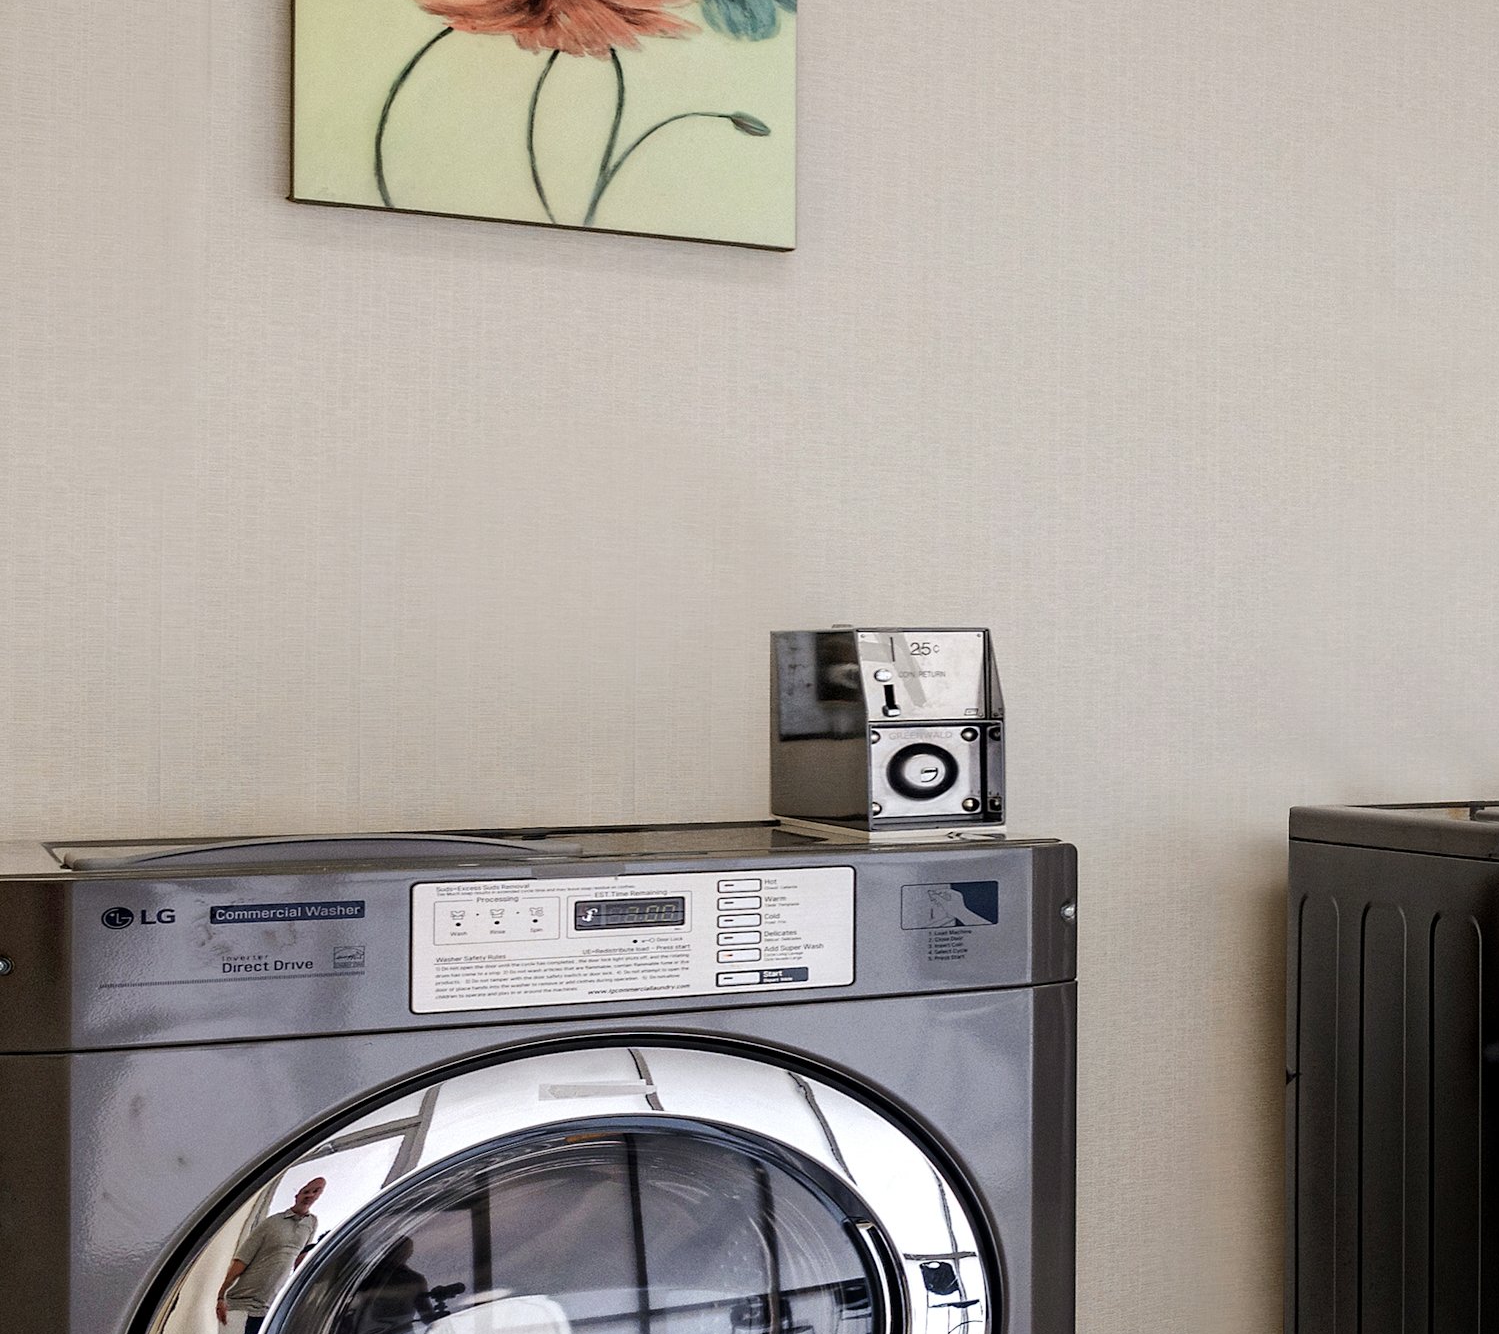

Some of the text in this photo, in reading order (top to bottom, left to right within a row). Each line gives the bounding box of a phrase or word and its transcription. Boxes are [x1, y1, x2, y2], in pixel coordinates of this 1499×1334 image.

[141, 909, 176, 925] LG
[215, 905, 360, 921] Commercial Washer
[222, 959, 314, 974] Direct Drive
